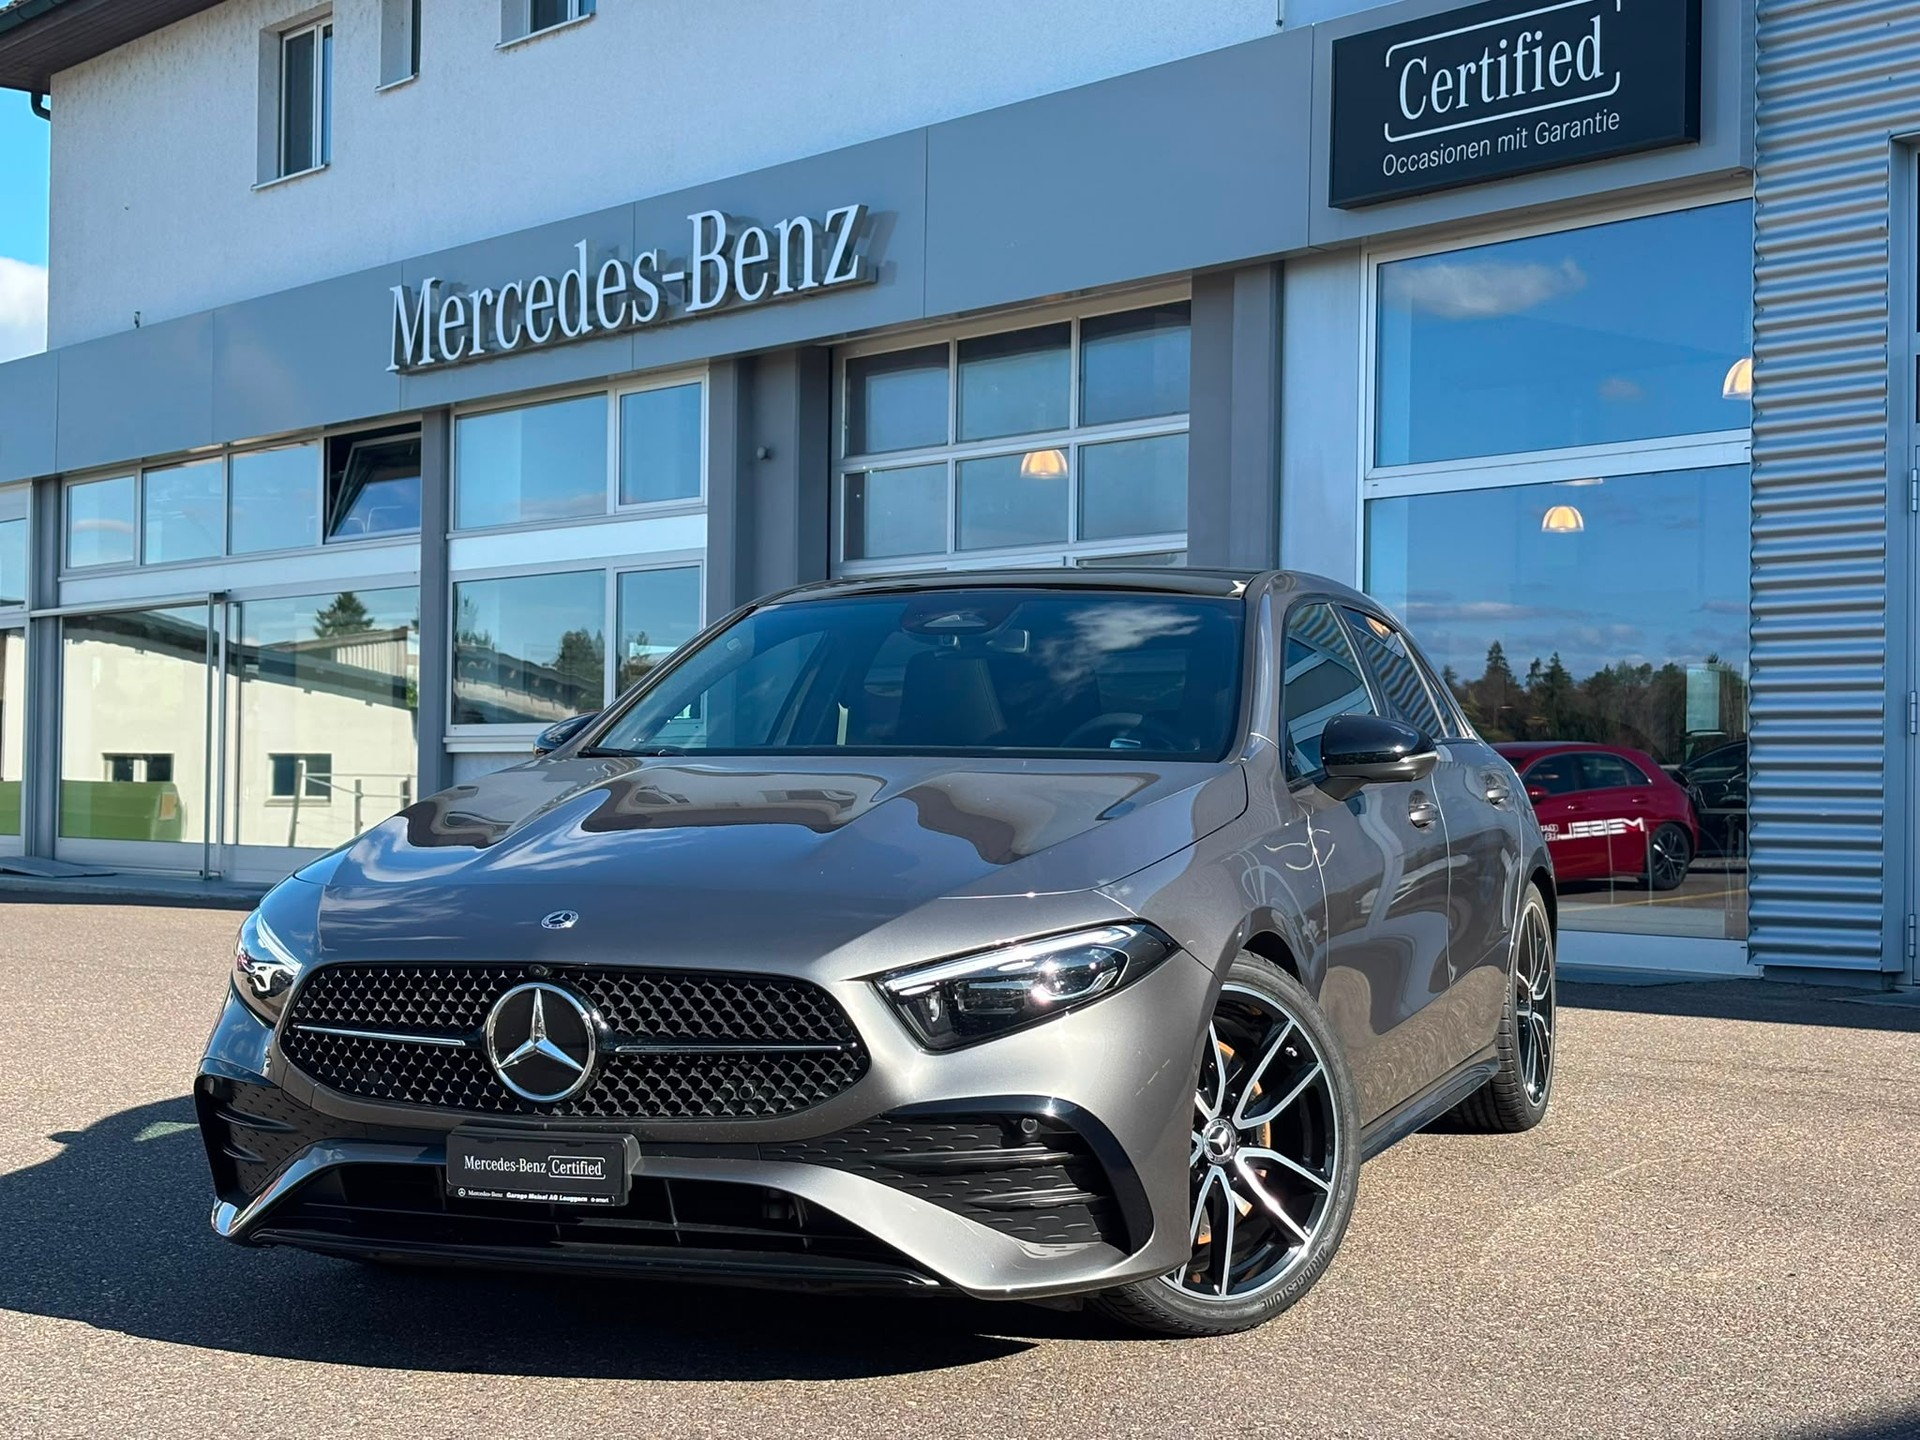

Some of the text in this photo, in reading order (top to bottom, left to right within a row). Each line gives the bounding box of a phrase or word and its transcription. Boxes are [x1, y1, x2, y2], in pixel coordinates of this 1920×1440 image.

[1400, 14, 1604, 120] Certified
[1382, 109, 1620, 176] Occasionen mit Garantie
[386, 204, 867, 373] Mercedes-Benz
[464, 1155, 602, 1175] Mercedes-Benz Certified
[506, 1191, 527, 1199] Garage
